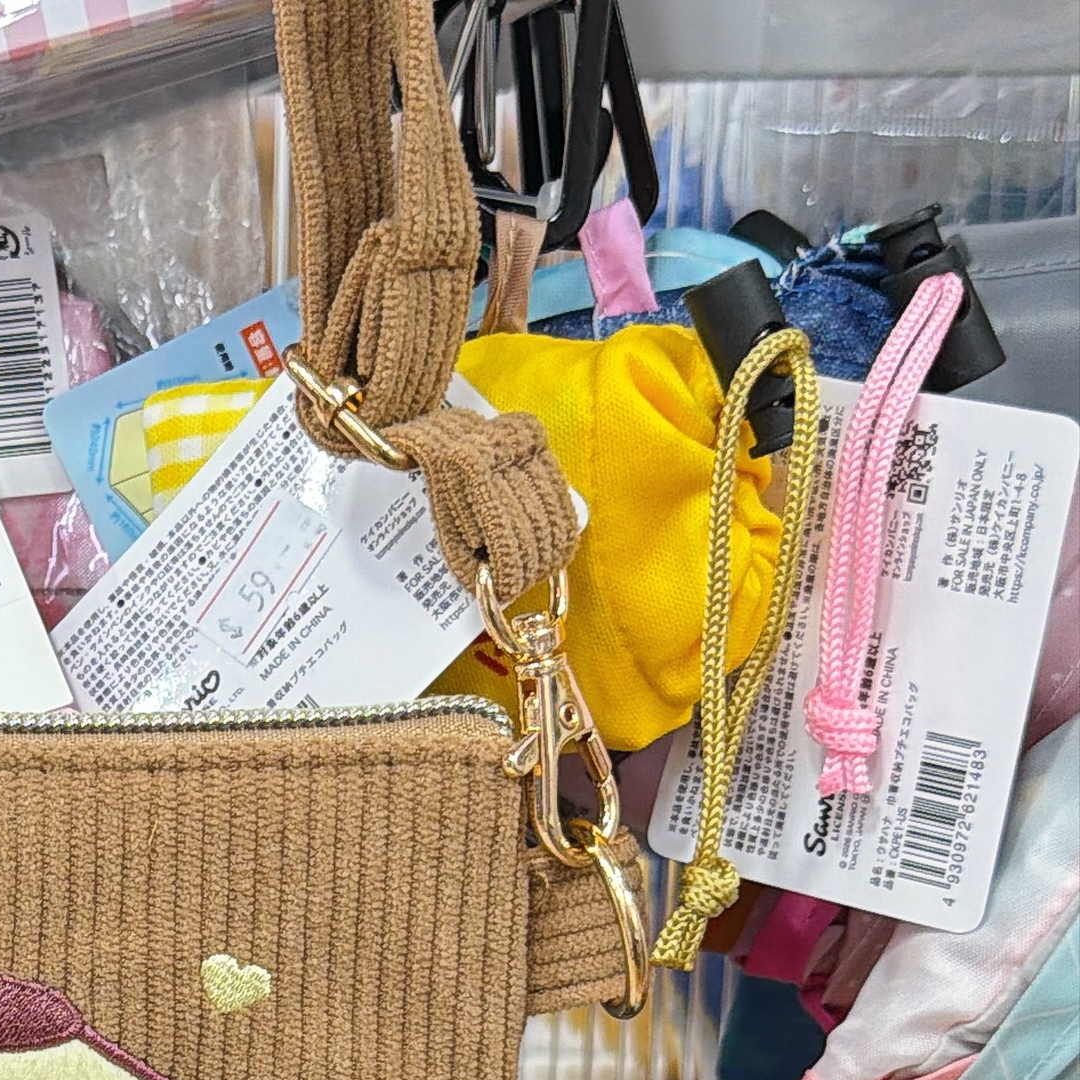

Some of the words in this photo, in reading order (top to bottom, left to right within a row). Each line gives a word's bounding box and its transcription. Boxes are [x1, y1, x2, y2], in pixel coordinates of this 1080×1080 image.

[971, 449, 987, 482] ONLY
[963, 482, 981, 523] JAPAN
[961, 523, 973, 536] IN
[955, 536, 970, 567] SALE
[402, 569, 425, 594] FOR
[420, 549, 443, 575] SAL
[950, 568, 964, 592] FOR
[978, 560, 995, 597] 発売元
[420, 577, 451, 612] 発売元
[258, 647, 293, 682] MADE
[286, 632, 307, 650] IN
[300, 603, 333, 636] CHINA
[879, 645, 899, 689] CHINA
[876, 689, 889, 704] IN
